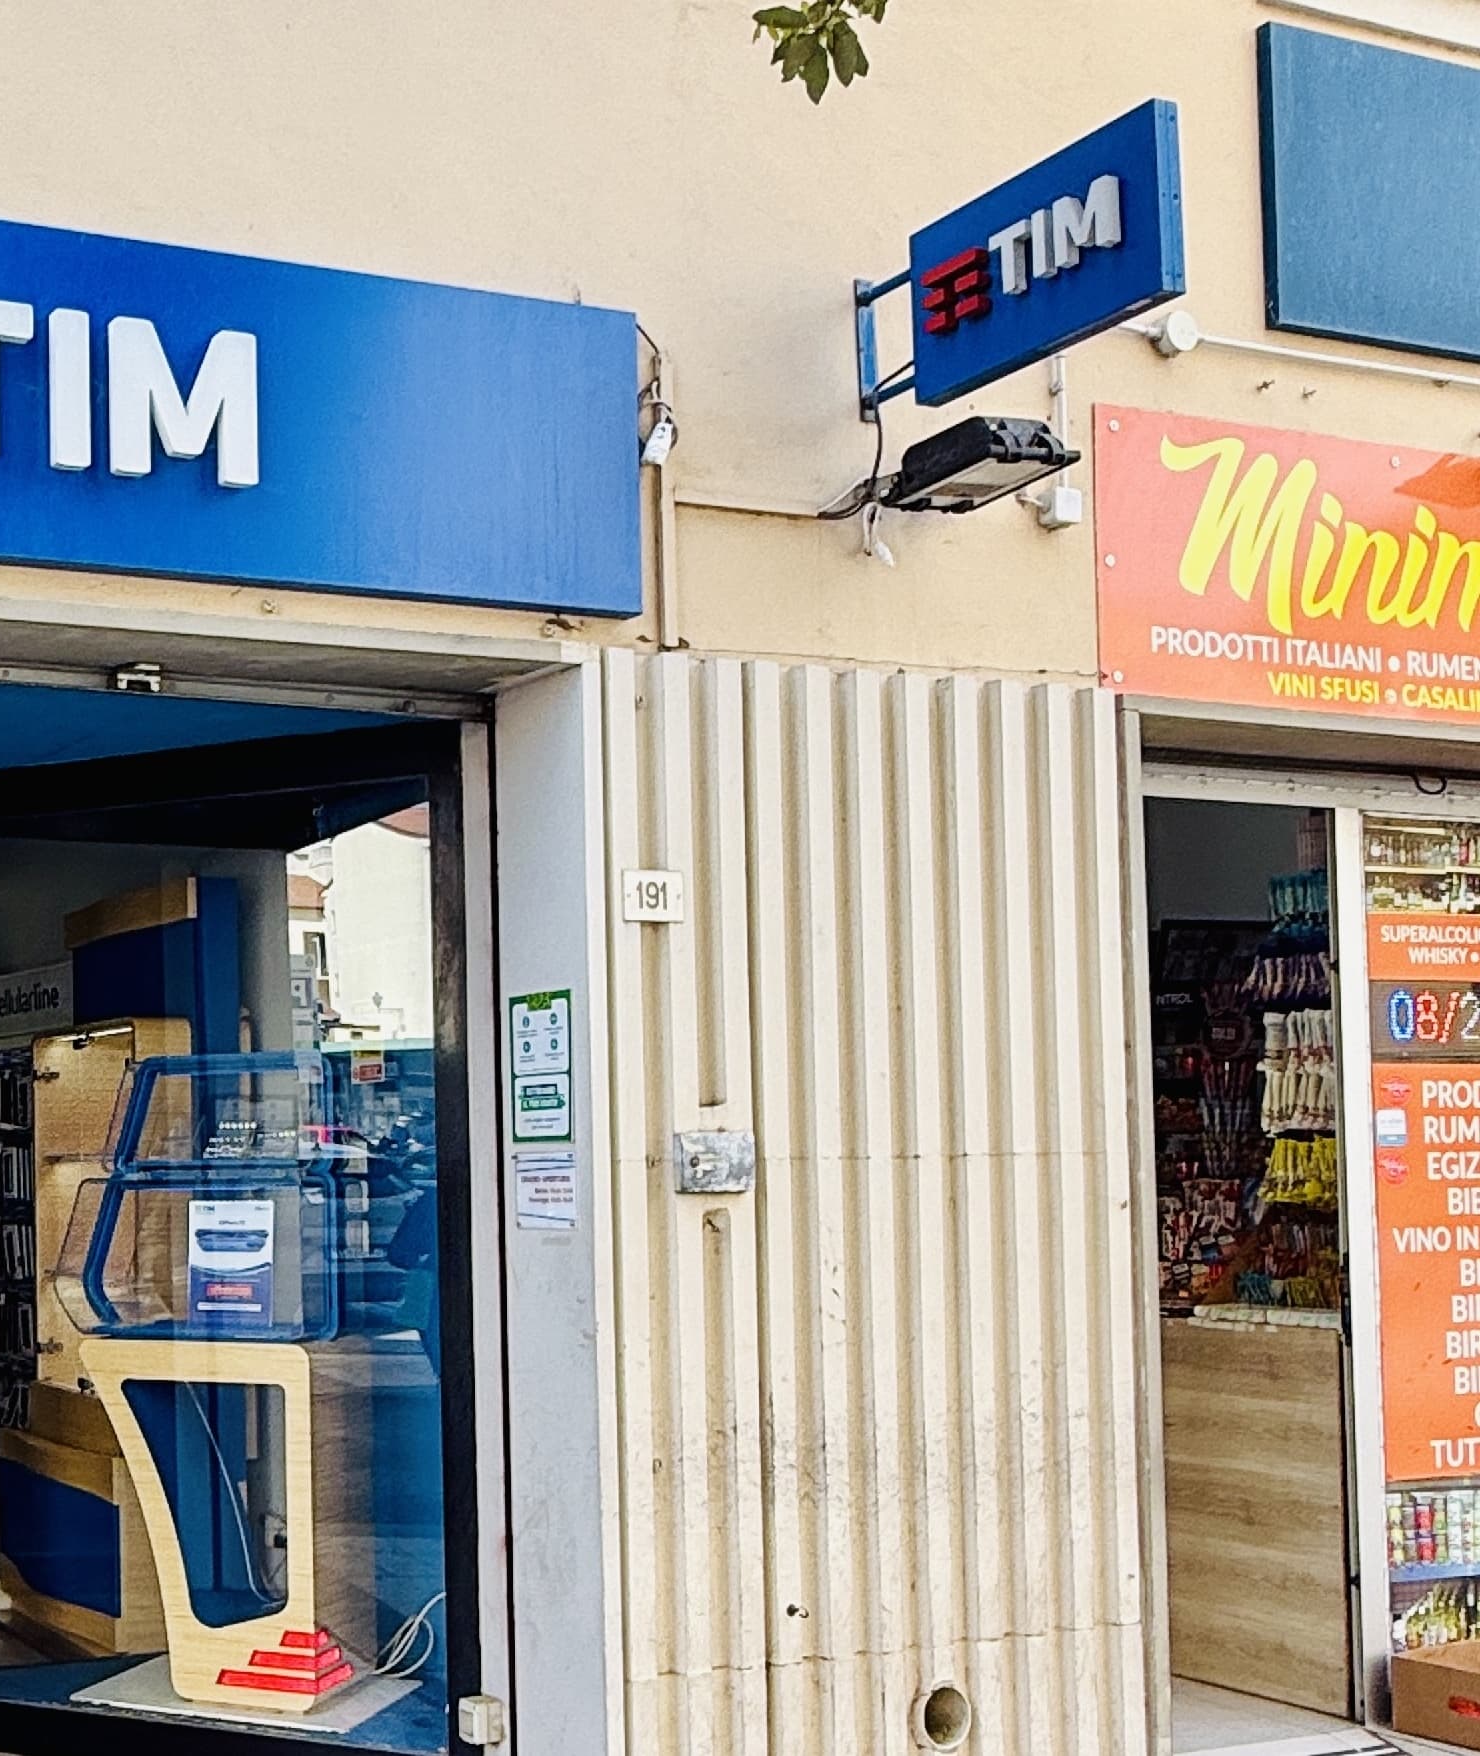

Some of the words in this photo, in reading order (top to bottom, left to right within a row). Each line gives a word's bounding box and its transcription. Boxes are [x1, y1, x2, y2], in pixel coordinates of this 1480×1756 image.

[988, 174, 1122, 296] TIM
[1150, 626, 1280, 665] PRODOTTI
[1285, 637, 1382, 673] ITALIANI
[1267, 671, 1316, 699] VINI
[1320, 675, 1380, 704] SFUSI
[1401, 683, 1480, 713] CASALI
[636, 880, 668, 910] 191
[1408, 946, 1469, 965] WHISKY
[1423, 1115, 1480, 1144] RUM
[1427, 1151, 1480, 1180] EGIZ
[1392, 1226, 1451, 1253] VINO
[1451, 1294, 1480, 1323] BI
[1453, 1365, 1480, 1395] BI
